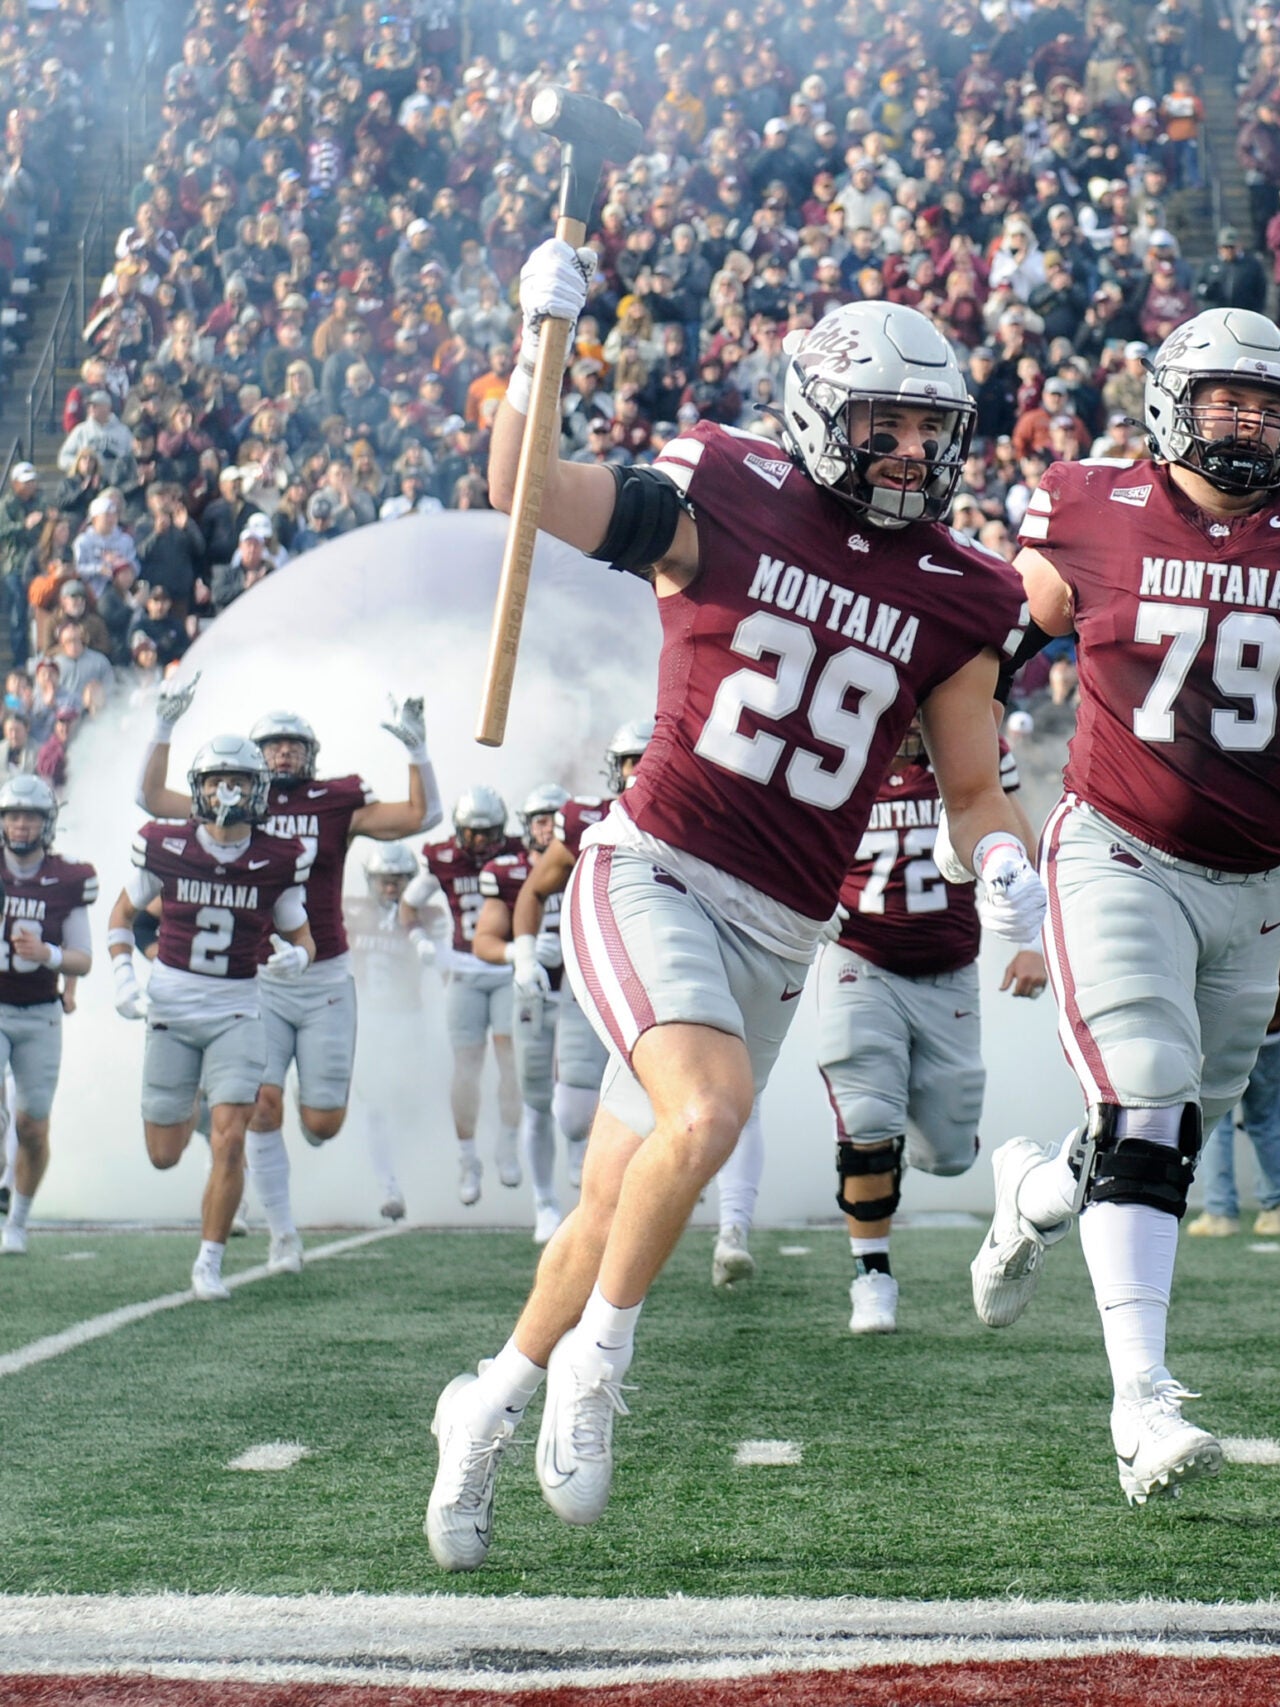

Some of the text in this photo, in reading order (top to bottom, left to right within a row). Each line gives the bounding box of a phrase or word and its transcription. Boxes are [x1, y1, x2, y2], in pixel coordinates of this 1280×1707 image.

[747, 553, 920, 664] MONTANA
[693, 609, 900, 811] 29
[867, 798, 941, 830] ONTAN
[176, 878, 258, 910] MONTANA
[854, 828, 949, 915] 72
[188, 906, 236, 977] 2
